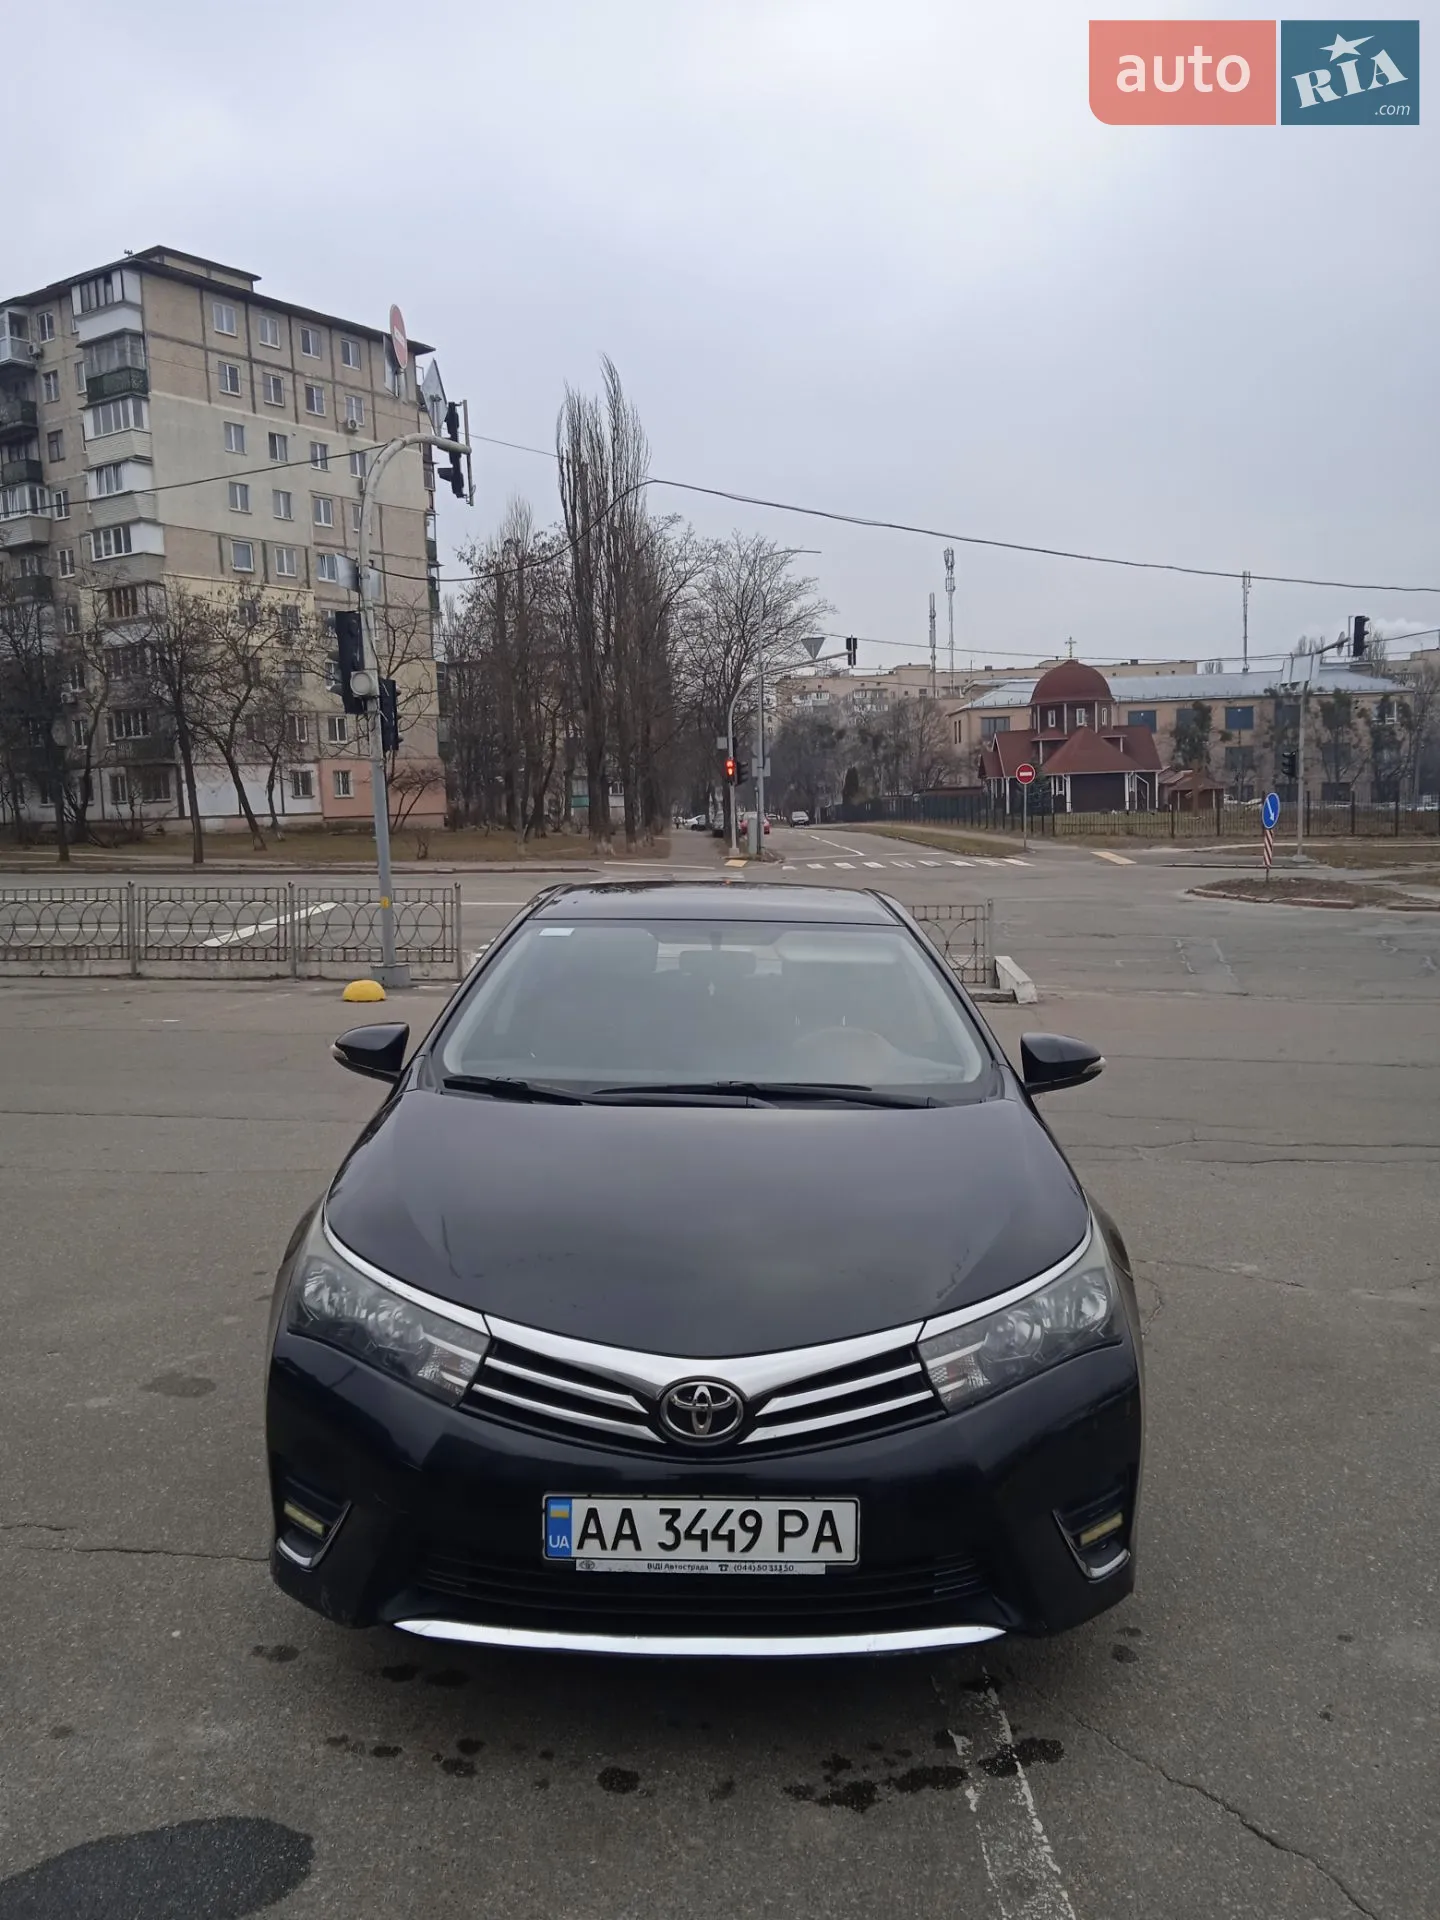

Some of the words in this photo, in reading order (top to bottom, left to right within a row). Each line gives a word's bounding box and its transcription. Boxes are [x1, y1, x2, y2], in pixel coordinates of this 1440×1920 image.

[549, 1535, 570, 1549] UA
[577, 1507, 642, 1551] AA
[657, 1508, 763, 1553] 3449
[777, 1509, 842, 1553] PA
